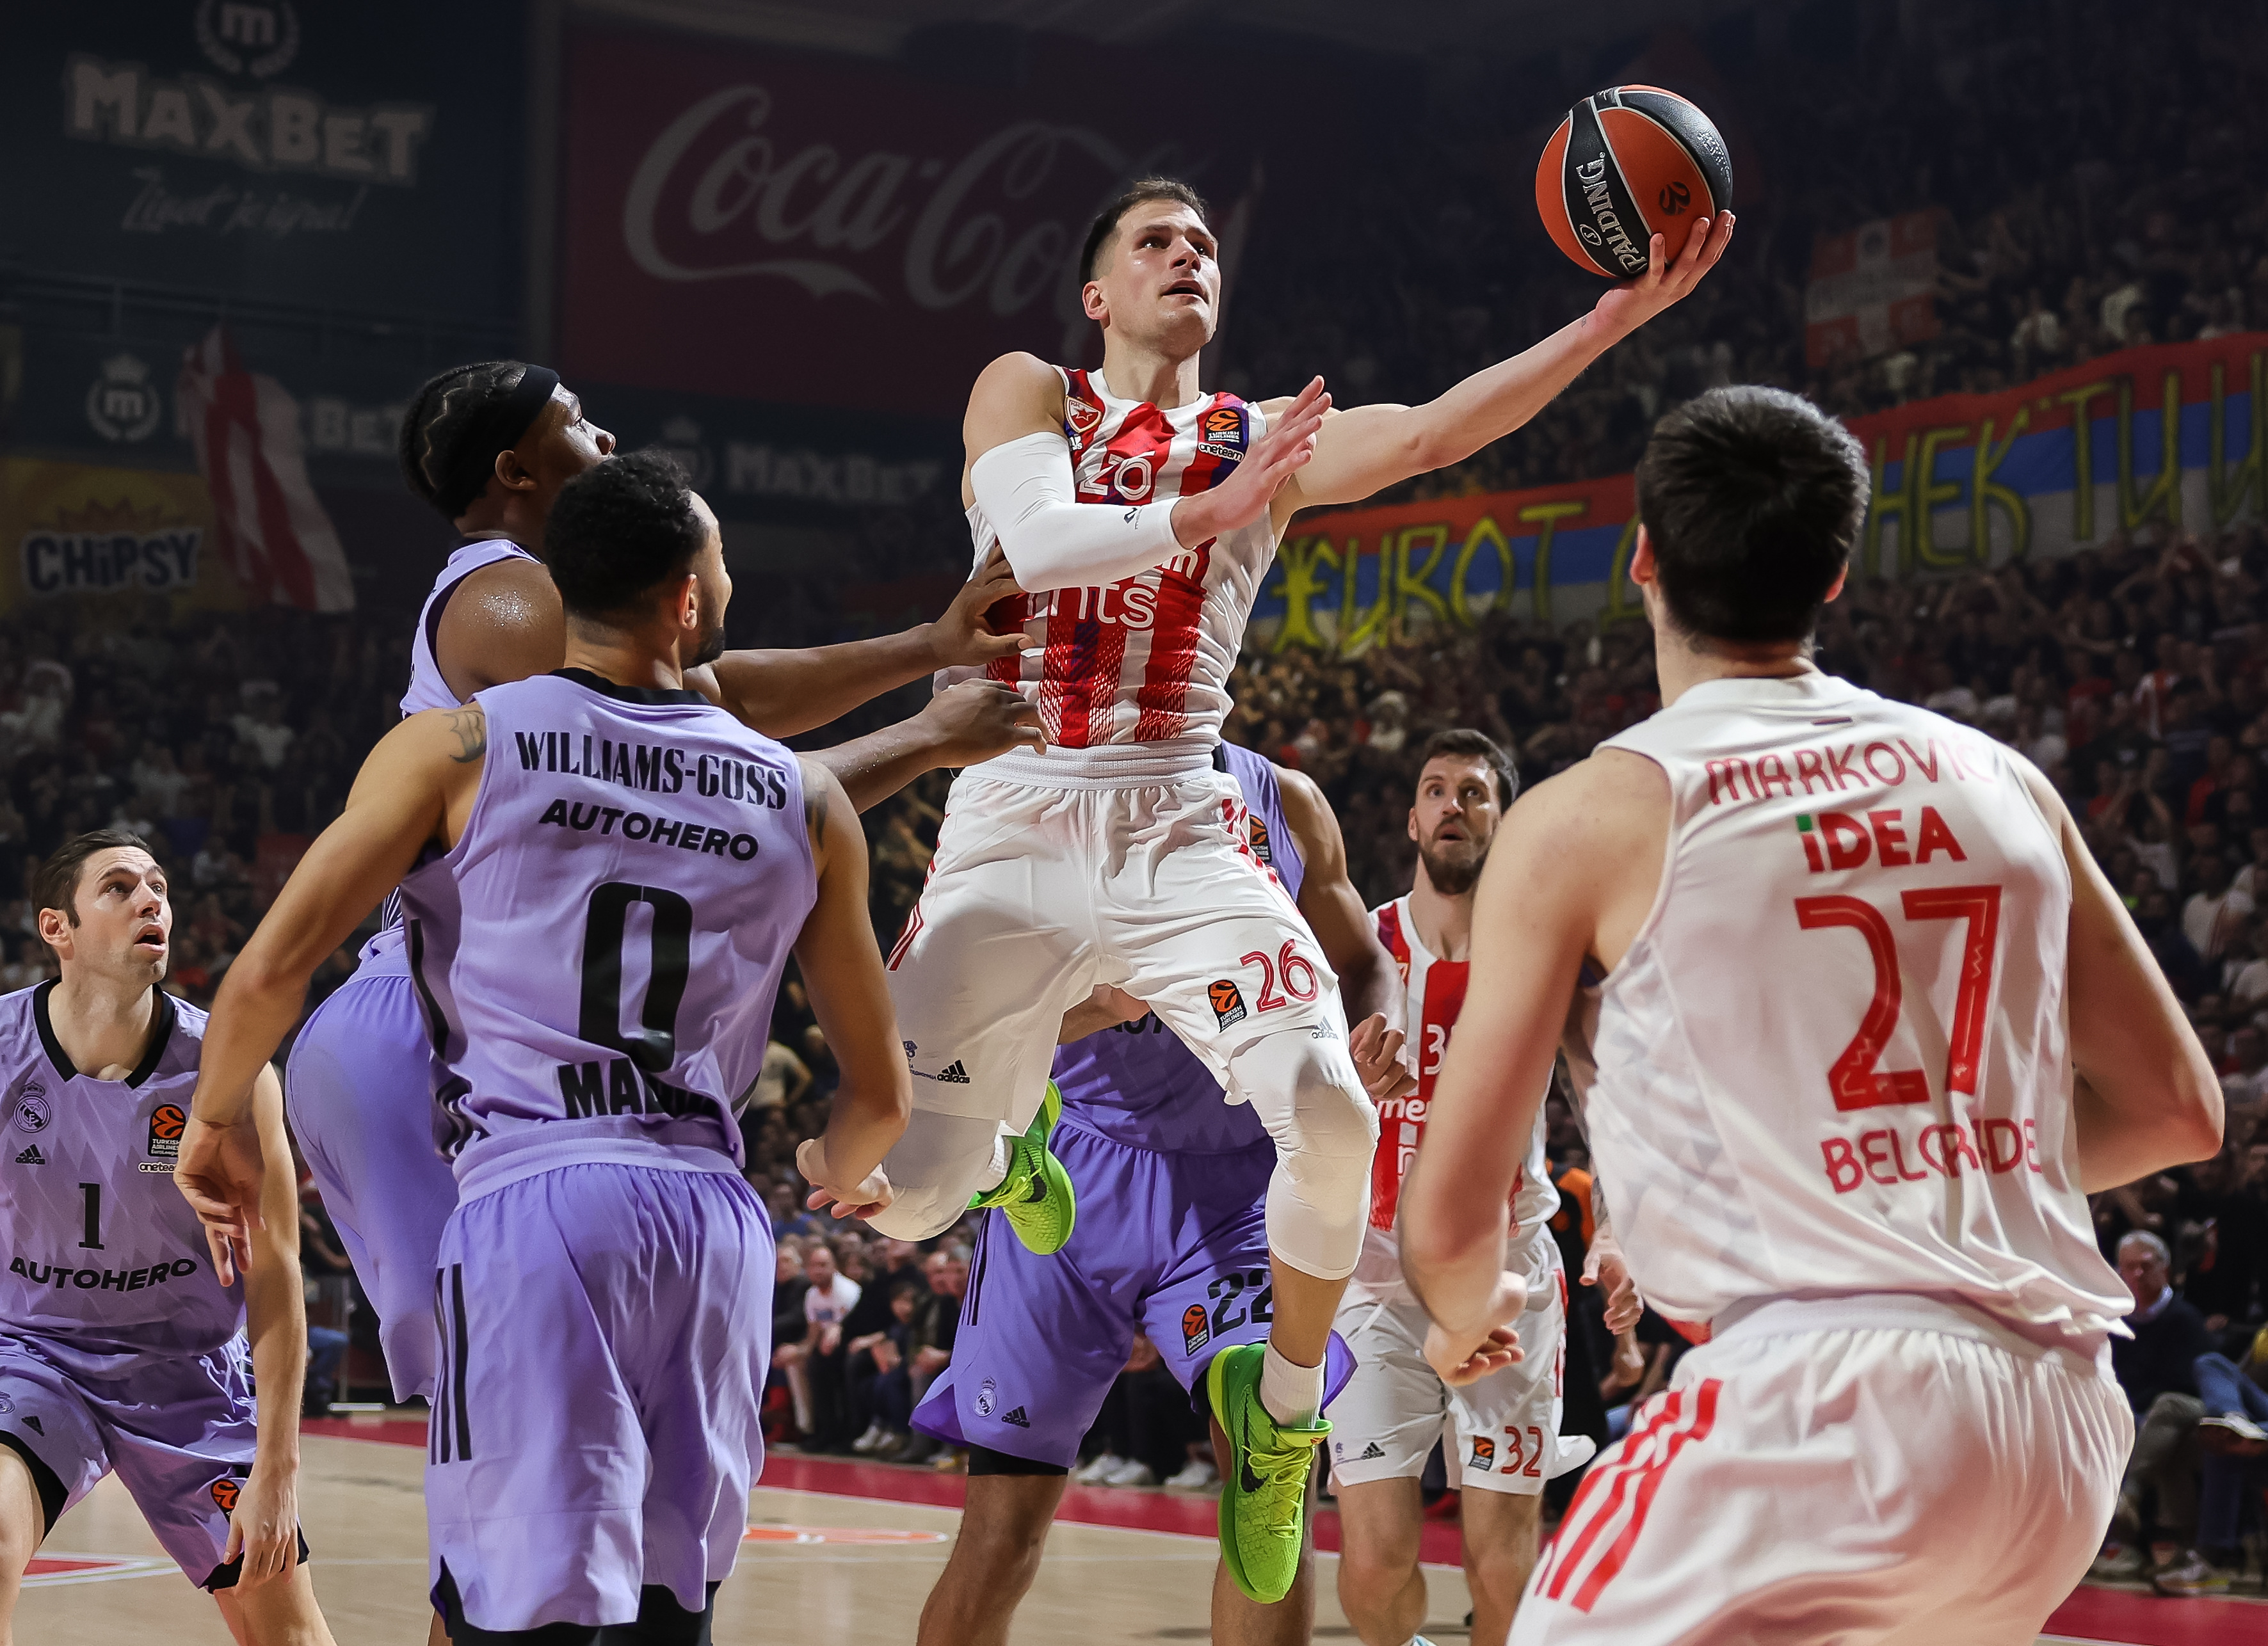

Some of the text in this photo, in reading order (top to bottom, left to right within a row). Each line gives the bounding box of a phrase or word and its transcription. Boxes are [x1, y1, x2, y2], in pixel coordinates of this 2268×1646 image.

[514, 731, 787, 810] WILLIAMS-GOSS
[539, 799, 760, 861] AUTOHERO
[578, 881, 693, 1073] 0
[1241, 939, 1320, 1013] 26
[1794, 885, 2002, 1112] 27
[1219, 1005, 1243, 1022] TURKISH
[1311, 1028, 1339, 1040] adidas
[1424, 1023, 1447, 1075] 3
[937, 1073, 970, 1083] adidas
[139, 1162, 175, 1172] onetea
[78, 1182, 104, 1250] 1
[9, 1257, 198, 1292] AUTOHERO
[1207, 1268, 1273, 1339] 22
[1500, 1425, 1543, 1478] 32
